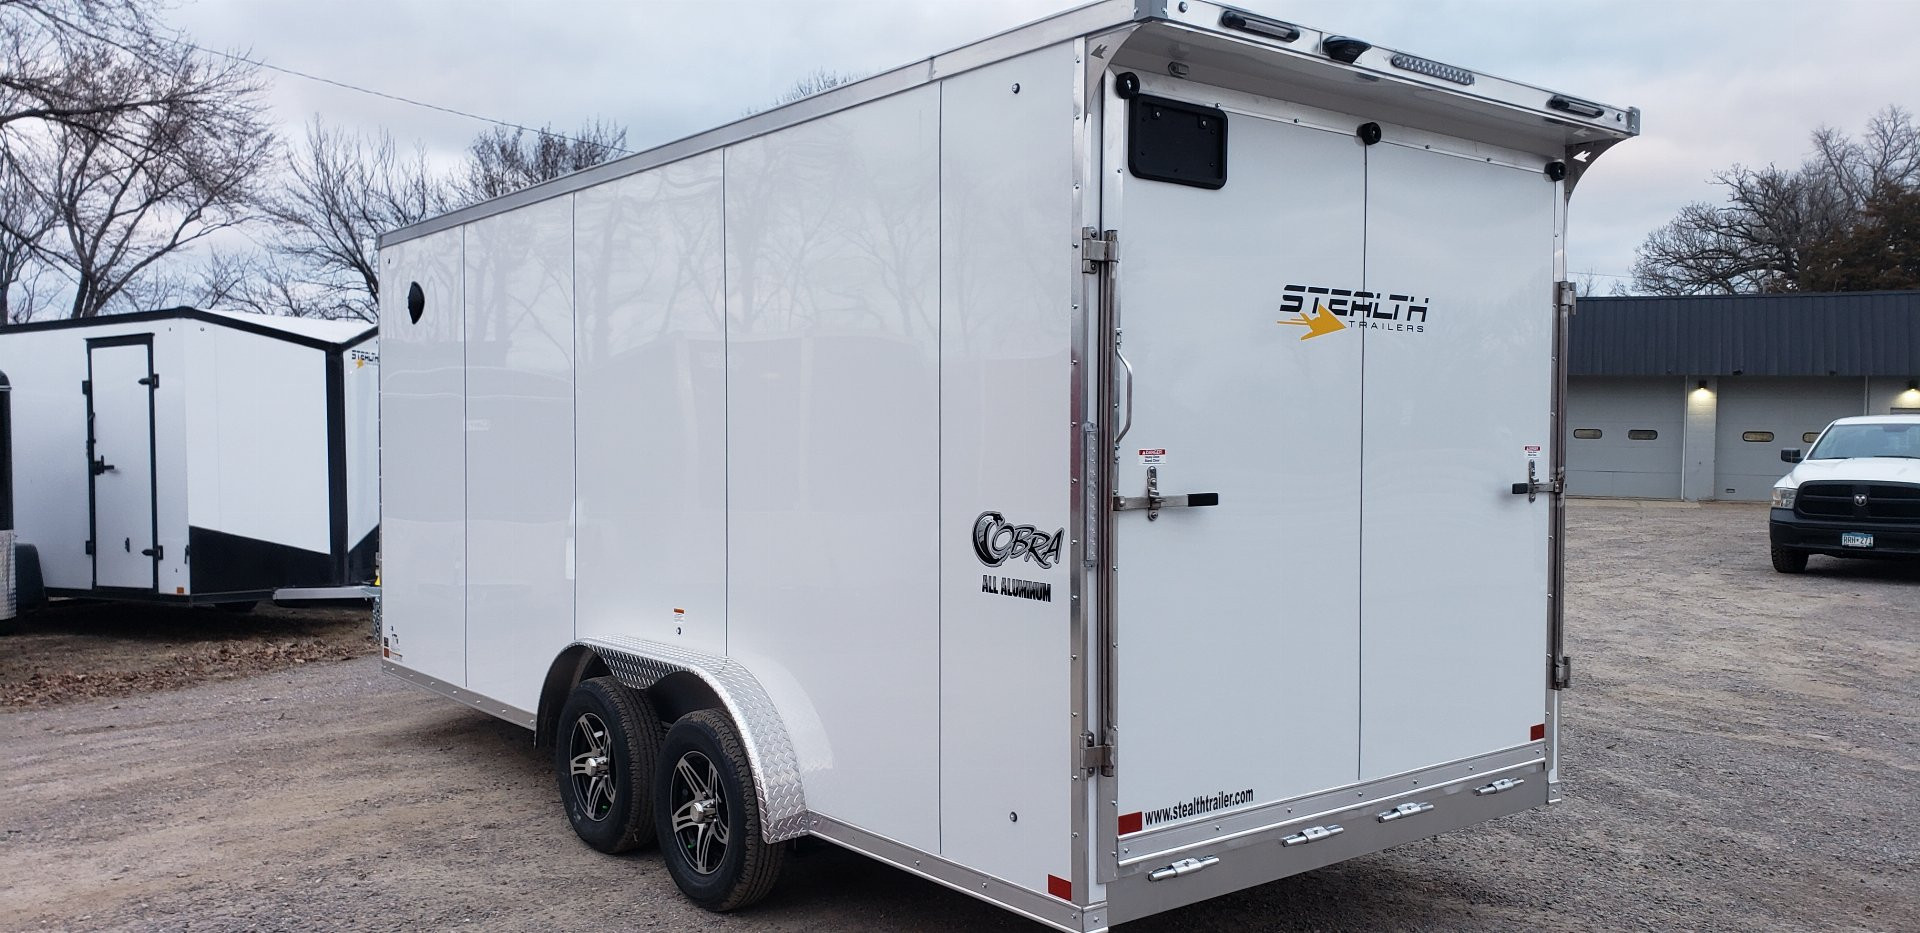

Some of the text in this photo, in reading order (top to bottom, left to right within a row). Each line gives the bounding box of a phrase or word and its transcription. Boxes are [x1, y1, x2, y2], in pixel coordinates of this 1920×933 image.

[1279, 284, 1430, 322] STEALTH
[1348, 320, 1425, 333] TRAILERS
[972, 510, 1065, 569] COBRA
[981, 574, 1052, 603] ALL ALUMINUM
[1144, 788, 1254, 826] www.stealthtrailer.com
